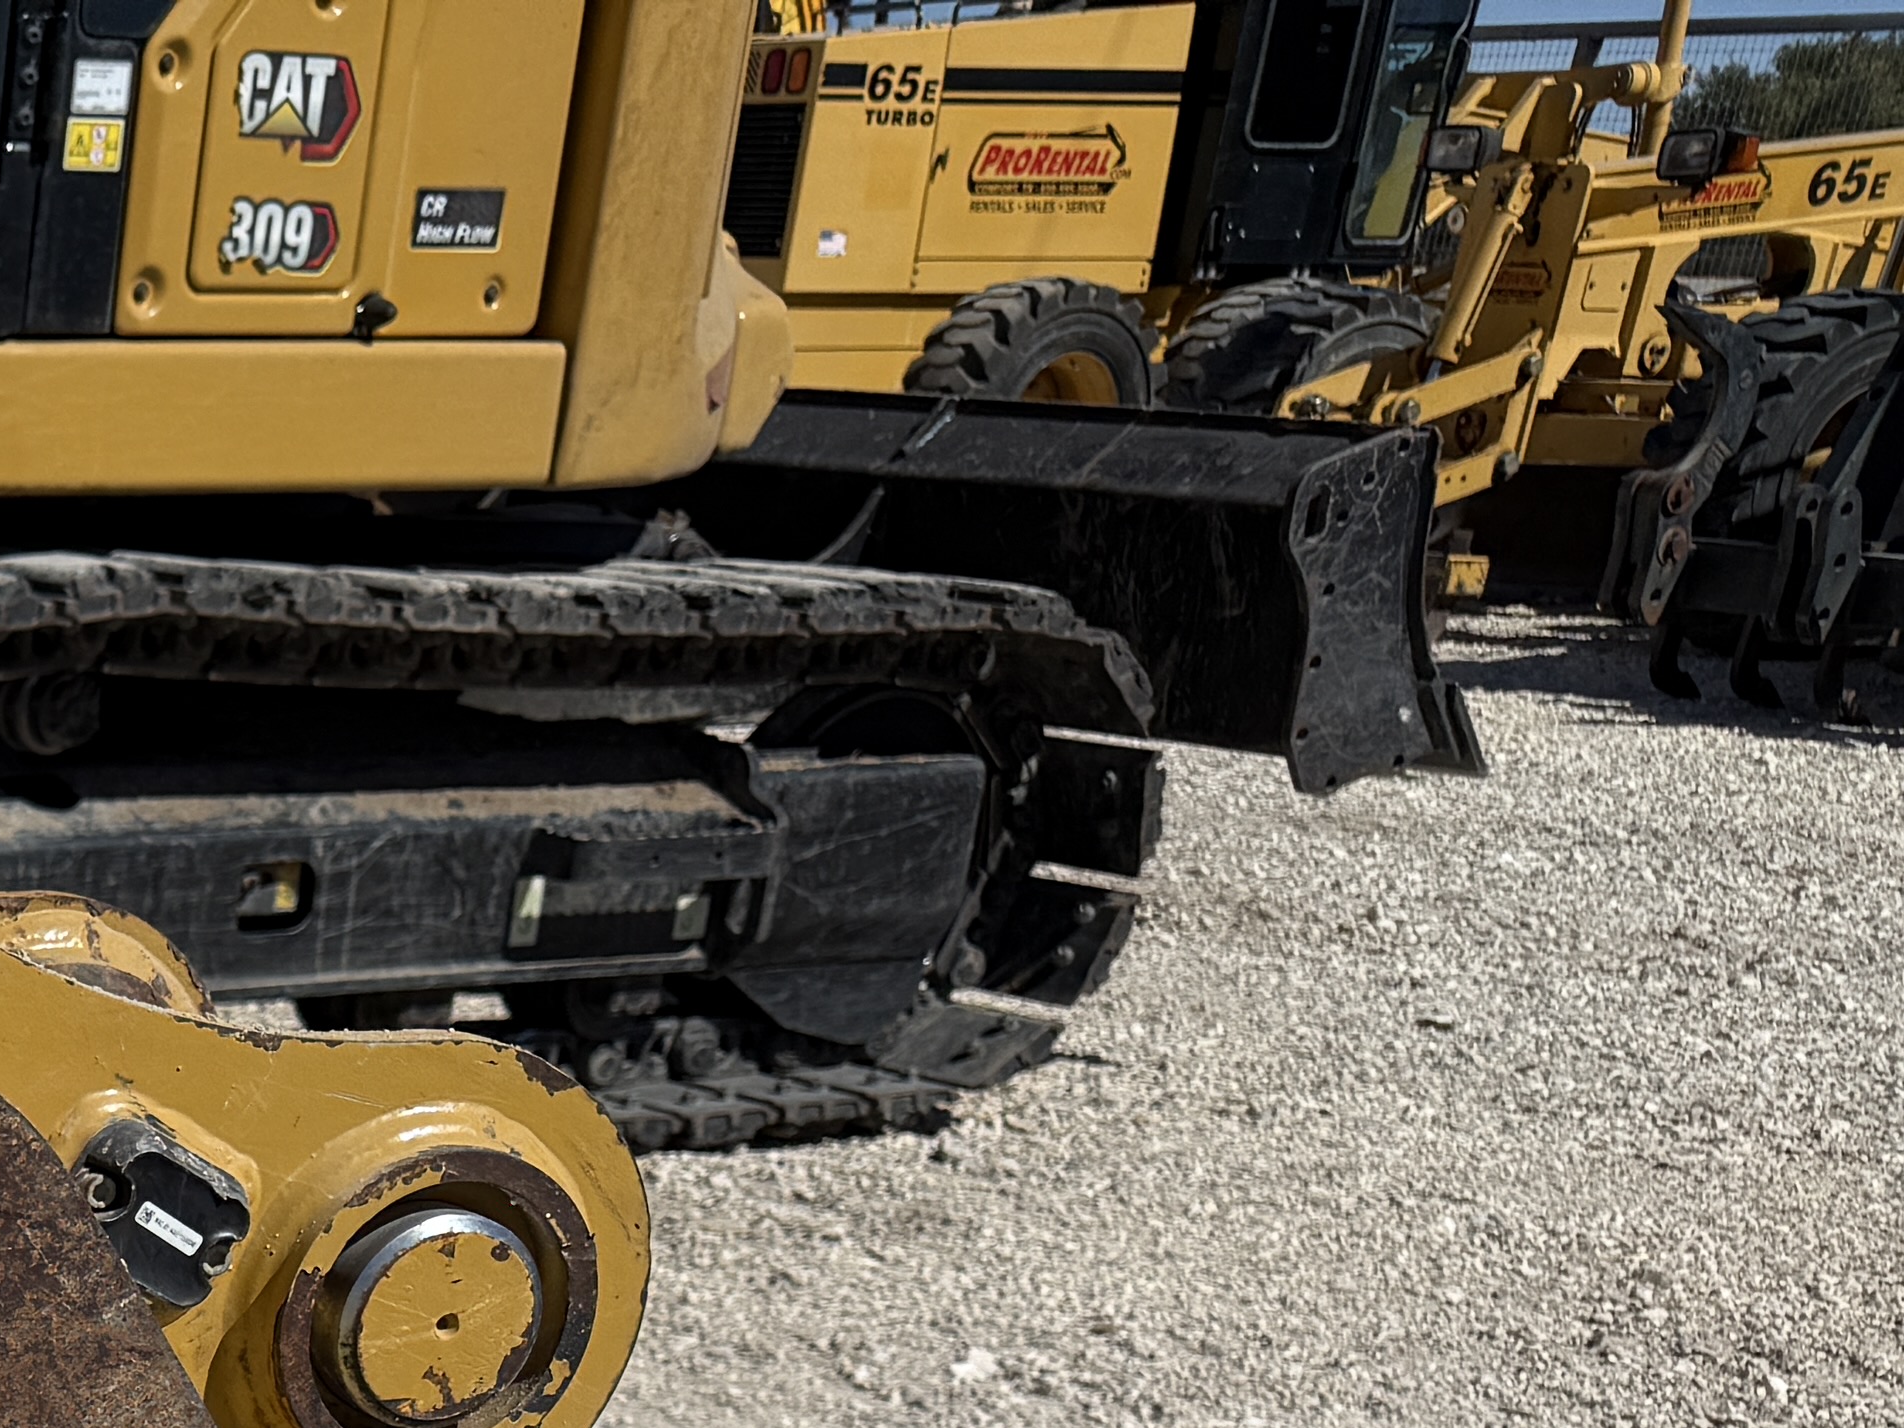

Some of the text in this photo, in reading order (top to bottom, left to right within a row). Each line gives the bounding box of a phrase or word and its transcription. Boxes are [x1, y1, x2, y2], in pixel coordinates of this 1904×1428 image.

[239, 52, 338, 138] CAT
[867, 64, 940, 104] 65E
[864, 109, 936, 127] TURBO
[1806, 155, 1893, 208] 65E
[419, 193, 448, 219] CR
[220, 198, 315, 270] 309
[415, 221, 496, 245] HIGH FLOW
